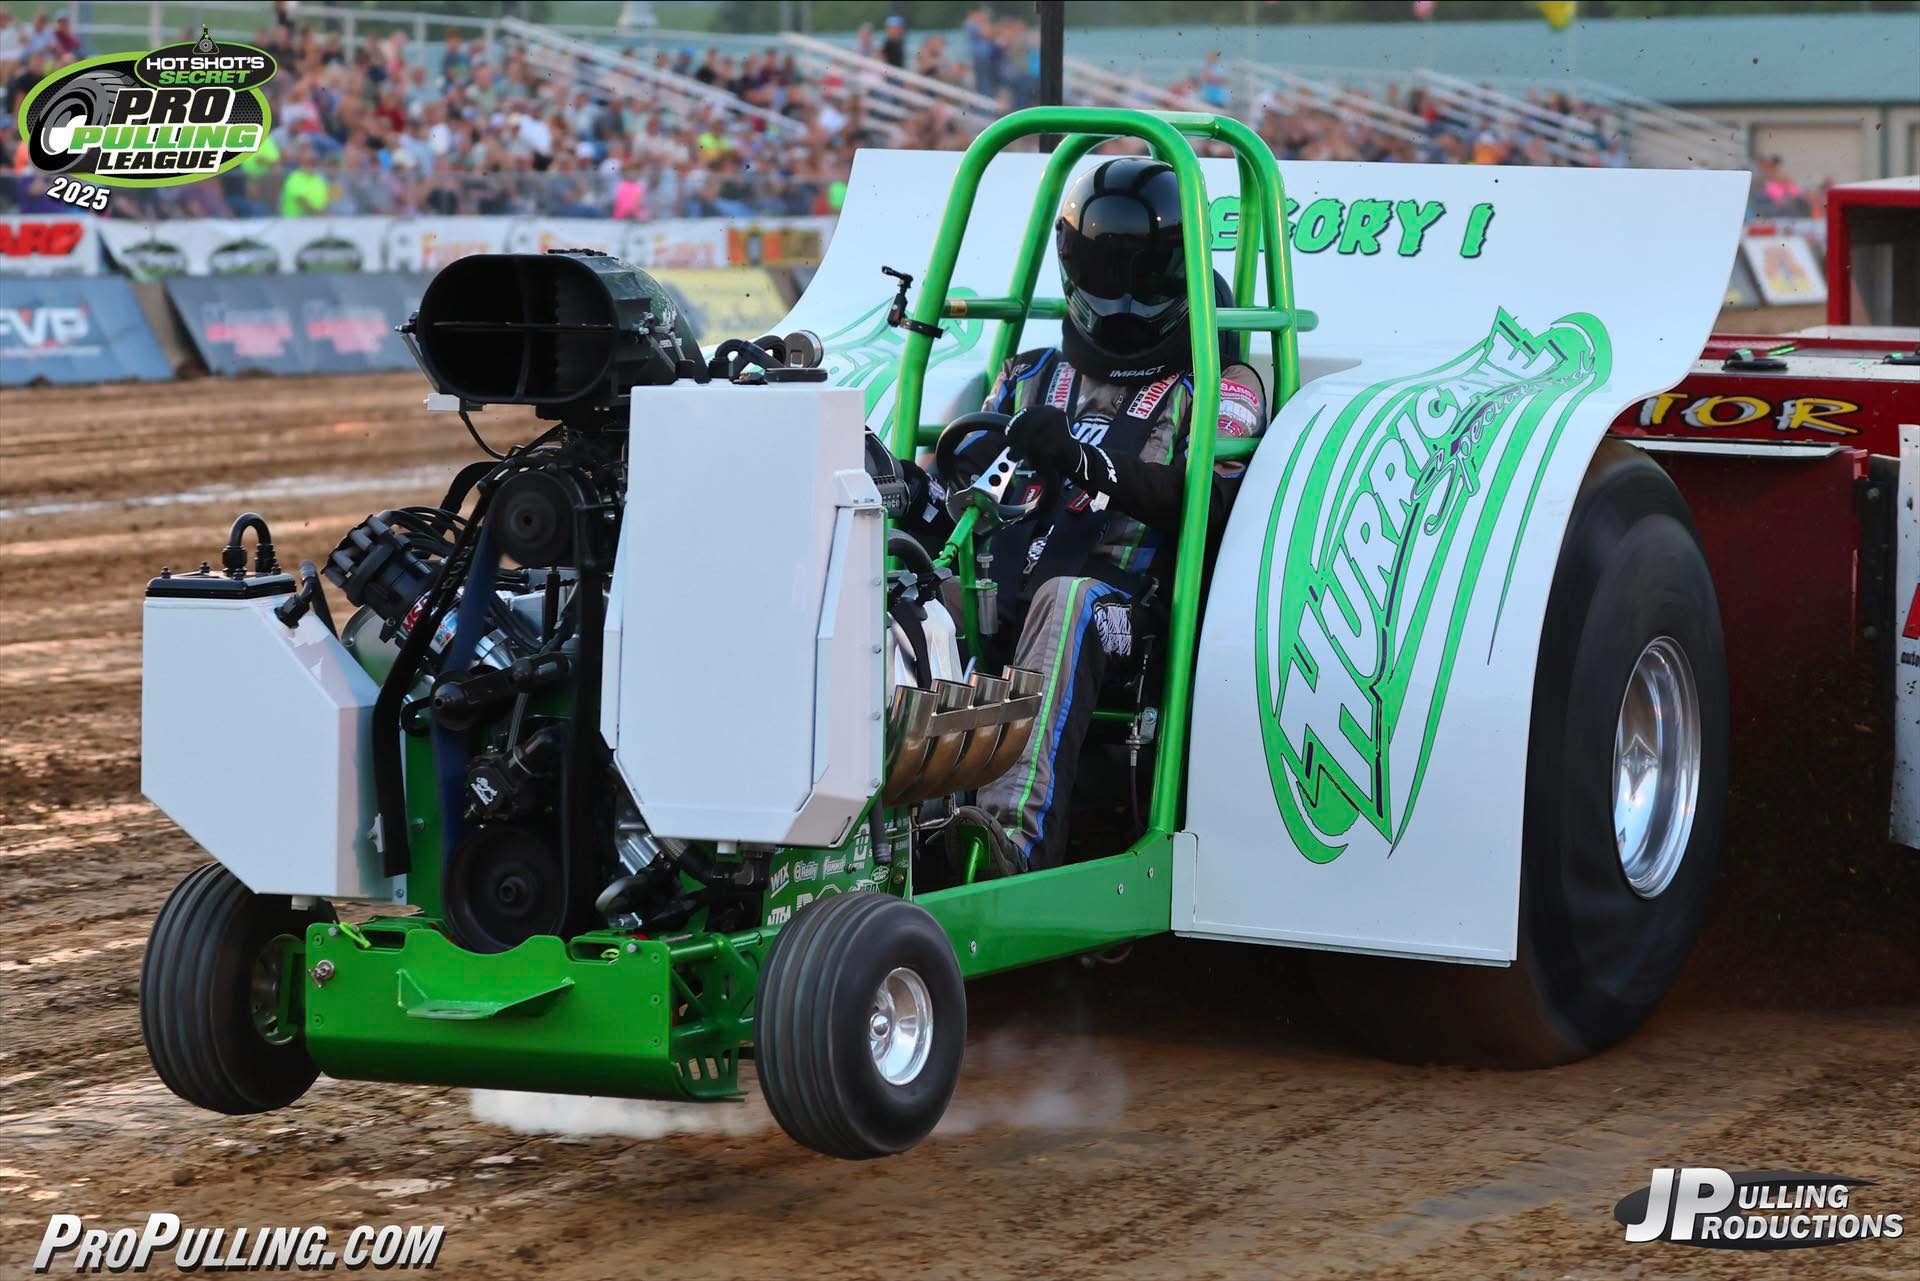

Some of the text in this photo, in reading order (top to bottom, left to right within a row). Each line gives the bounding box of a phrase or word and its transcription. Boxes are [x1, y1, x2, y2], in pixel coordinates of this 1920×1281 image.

[1109, 365, 1166, 378] IMPACT
[1276, 318, 1568, 818] HURRICANE
[770, 862, 790, 893] WIX
